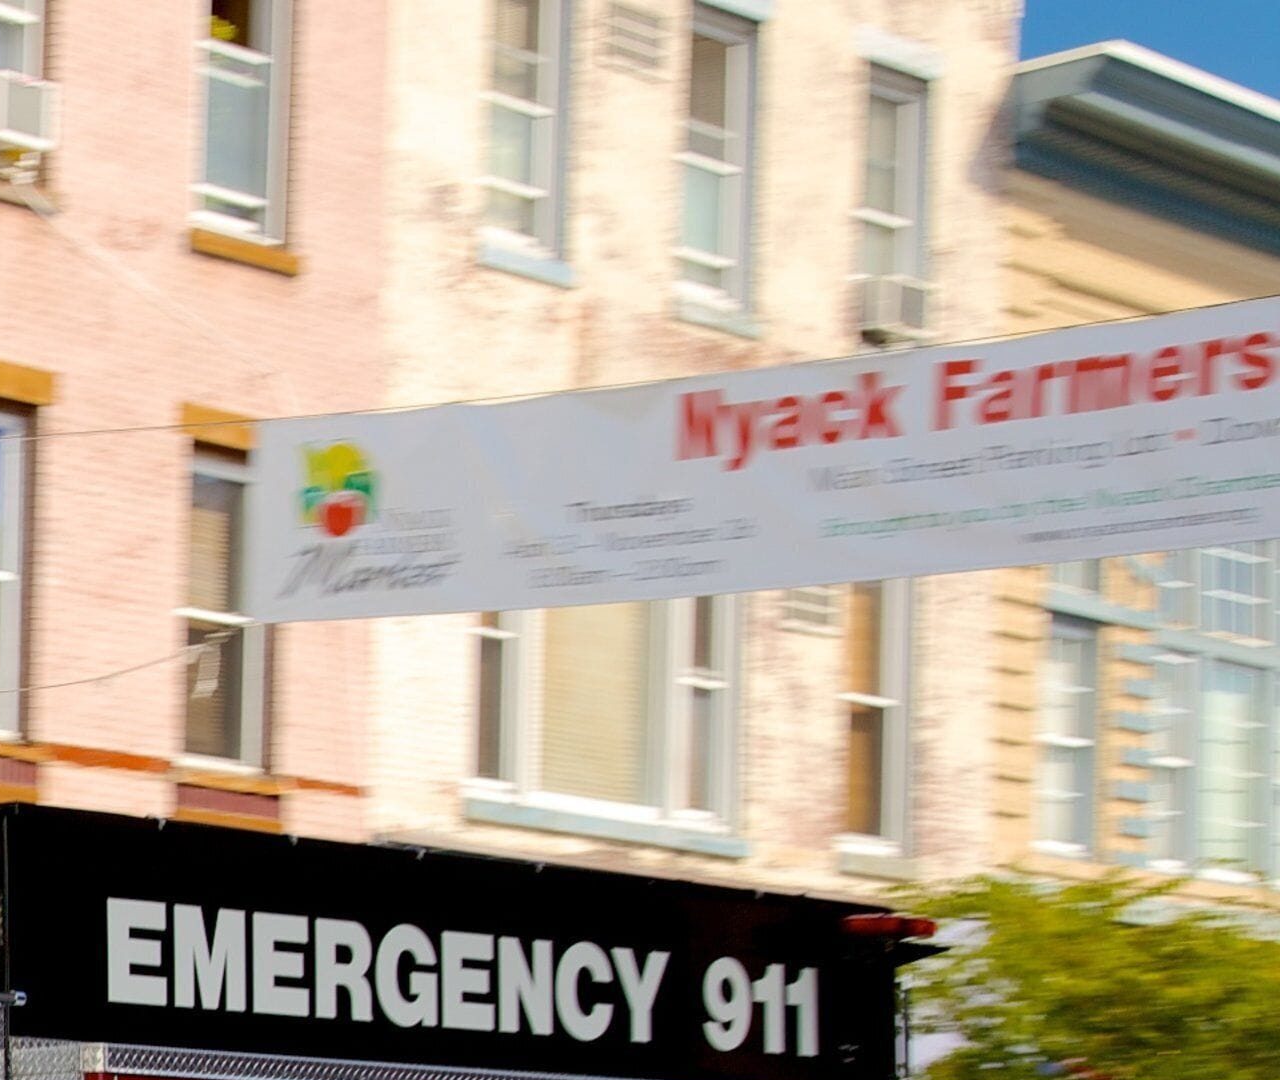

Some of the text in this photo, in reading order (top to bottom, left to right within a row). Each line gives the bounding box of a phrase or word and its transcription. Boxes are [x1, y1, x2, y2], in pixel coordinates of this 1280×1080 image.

[674, 331, 1280, 472] Nyack Farmers
[984, 436, 1105, 473] Parking
[107, 897, 819, 1057] EMERGENCY 911
